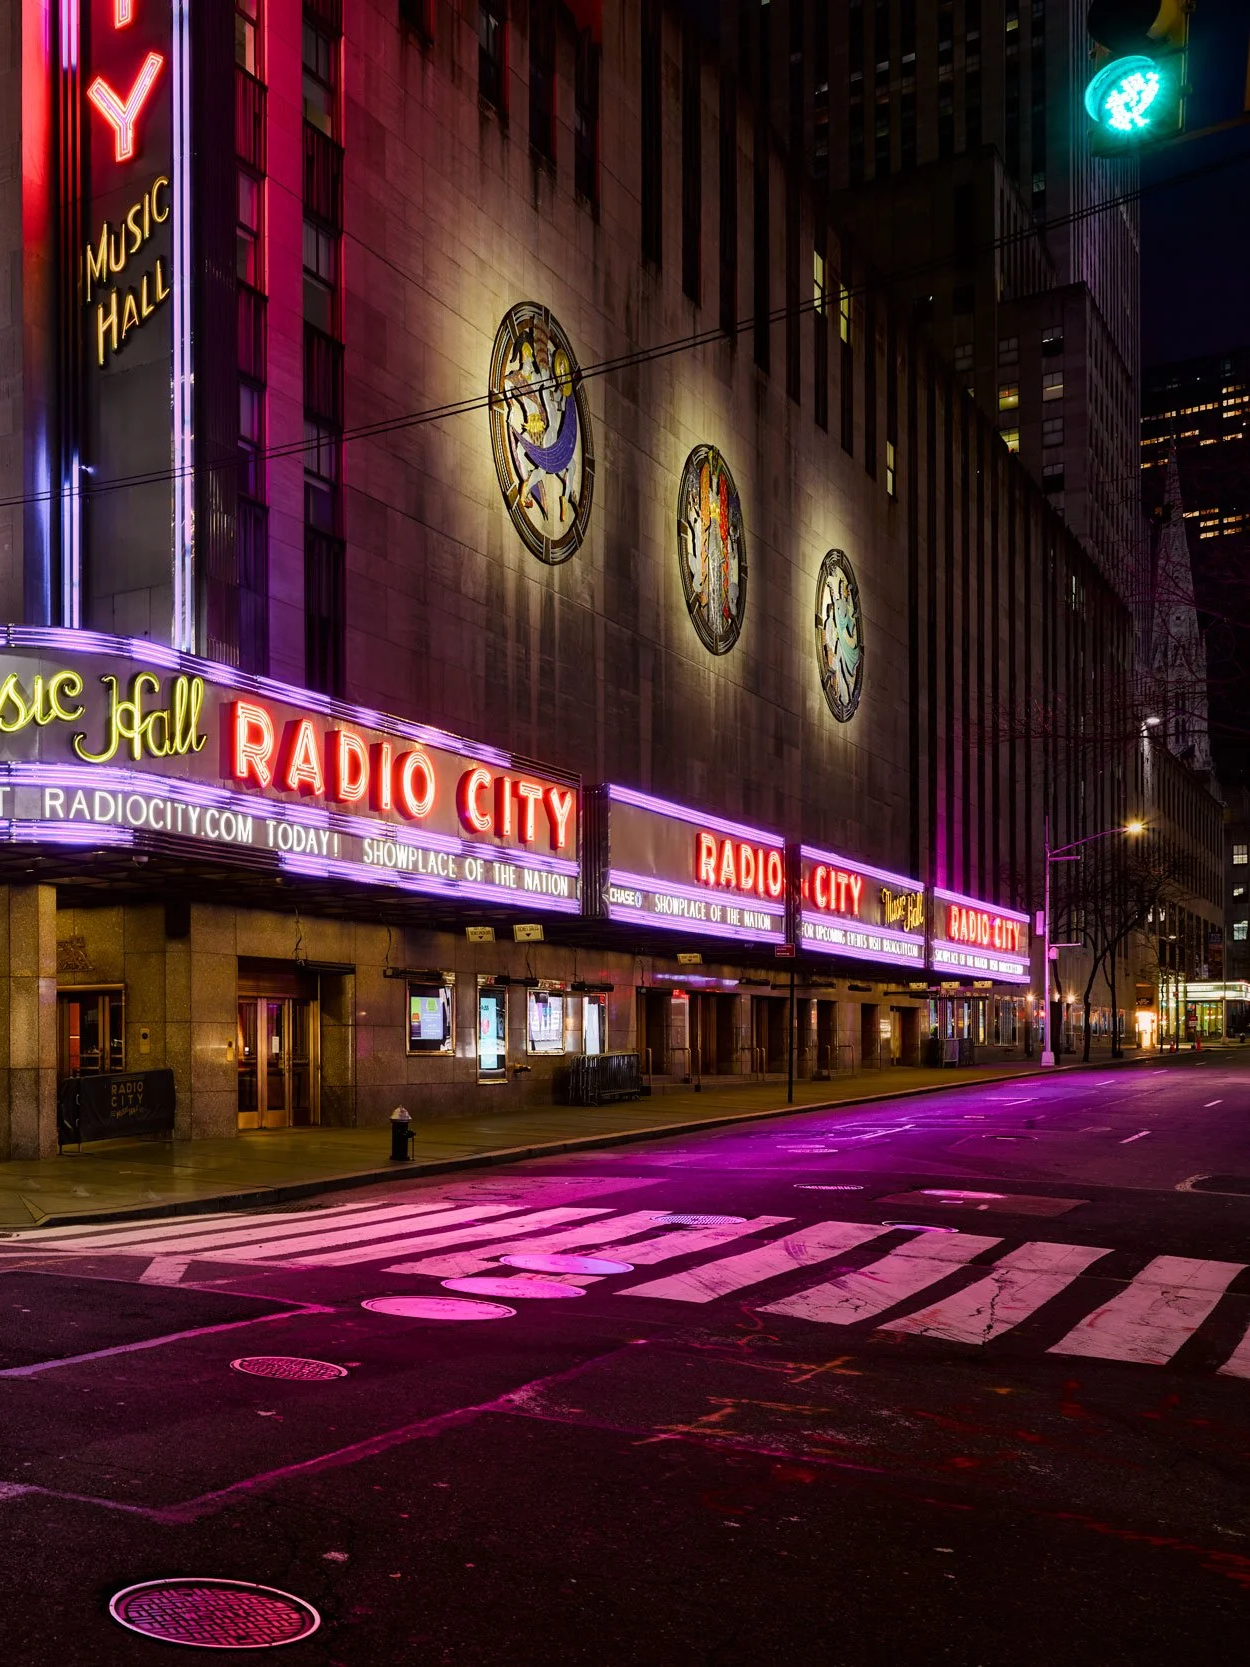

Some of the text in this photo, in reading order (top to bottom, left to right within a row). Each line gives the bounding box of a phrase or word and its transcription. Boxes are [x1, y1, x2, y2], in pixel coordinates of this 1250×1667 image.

[87, 0, 165, 163] Y
[86, 175, 170, 302] MUSIC
[97, 259, 170, 366] HALL
[73, 670, 208, 764] Hall
[230, 699, 436, 819] RADIO
[461, 767, 574, 849] CITY
[44, 788, 252, 844] RADIOCITY.COM
[265, 819, 340, 858] TODAY!
[362, 839, 457, 880] SHOWPLACE
[464, 855, 484, 883] OF
[492, 863, 517, 892] THE
[523, 868, 568, 897] NATION
[699, 832, 783, 897] RADIO
[609, 887, 635, 906] CHASE
[654, 894, 771, 931] SHOWPLACE OF THE NATION
[814, 865, 863, 915] CITY
[815, 925, 846, 944] UPCOMING
[846, 930, 868, 949] EVENTS
[950, 904, 1021, 951] RADIO CITY
[111, 1081, 144, 1096] RADIO
[111, 1093, 144, 1108] CITY
